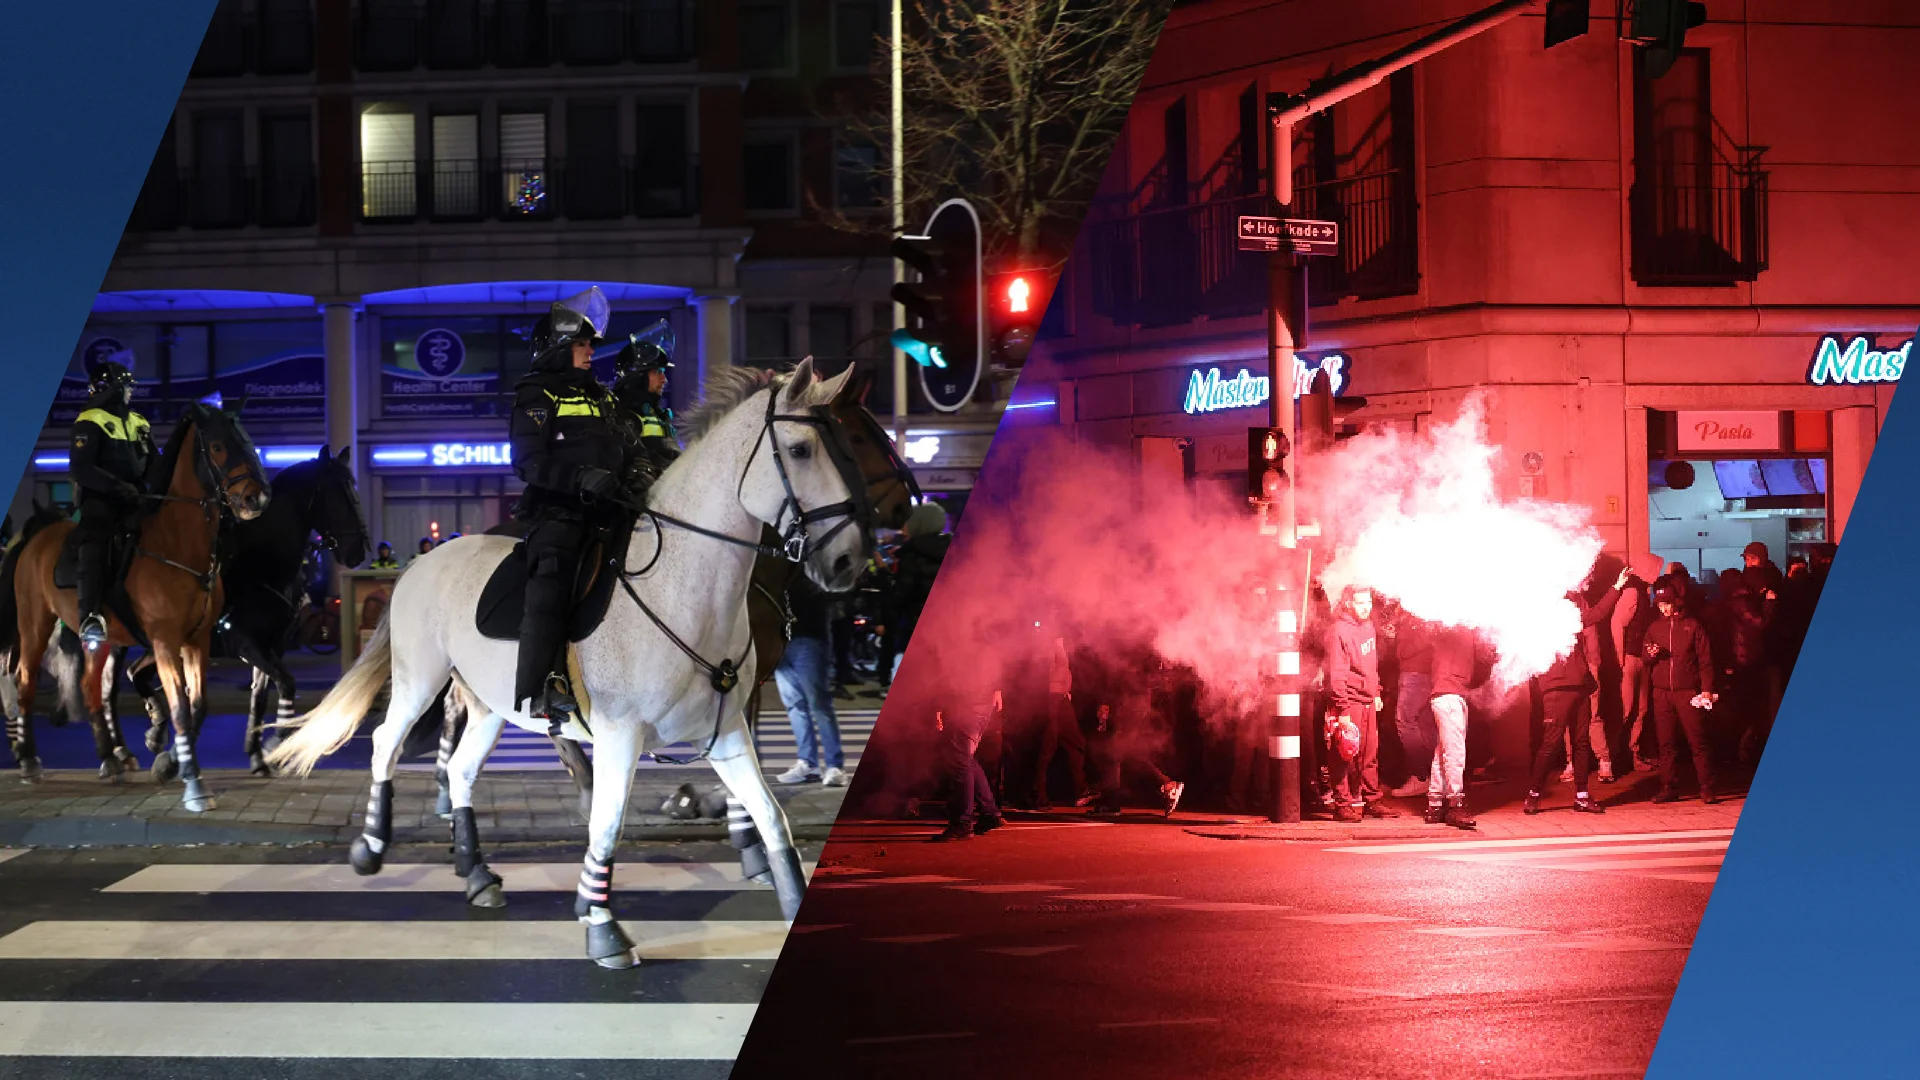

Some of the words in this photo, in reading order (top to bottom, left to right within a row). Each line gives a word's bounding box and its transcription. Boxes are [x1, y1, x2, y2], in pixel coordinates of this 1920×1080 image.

[245, 382, 323, 397] Diagnostiek
[393, 380, 437, 394] Health
[440, 379, 487, 393] Center
[1694, 421, 1753, 441] Pasta
